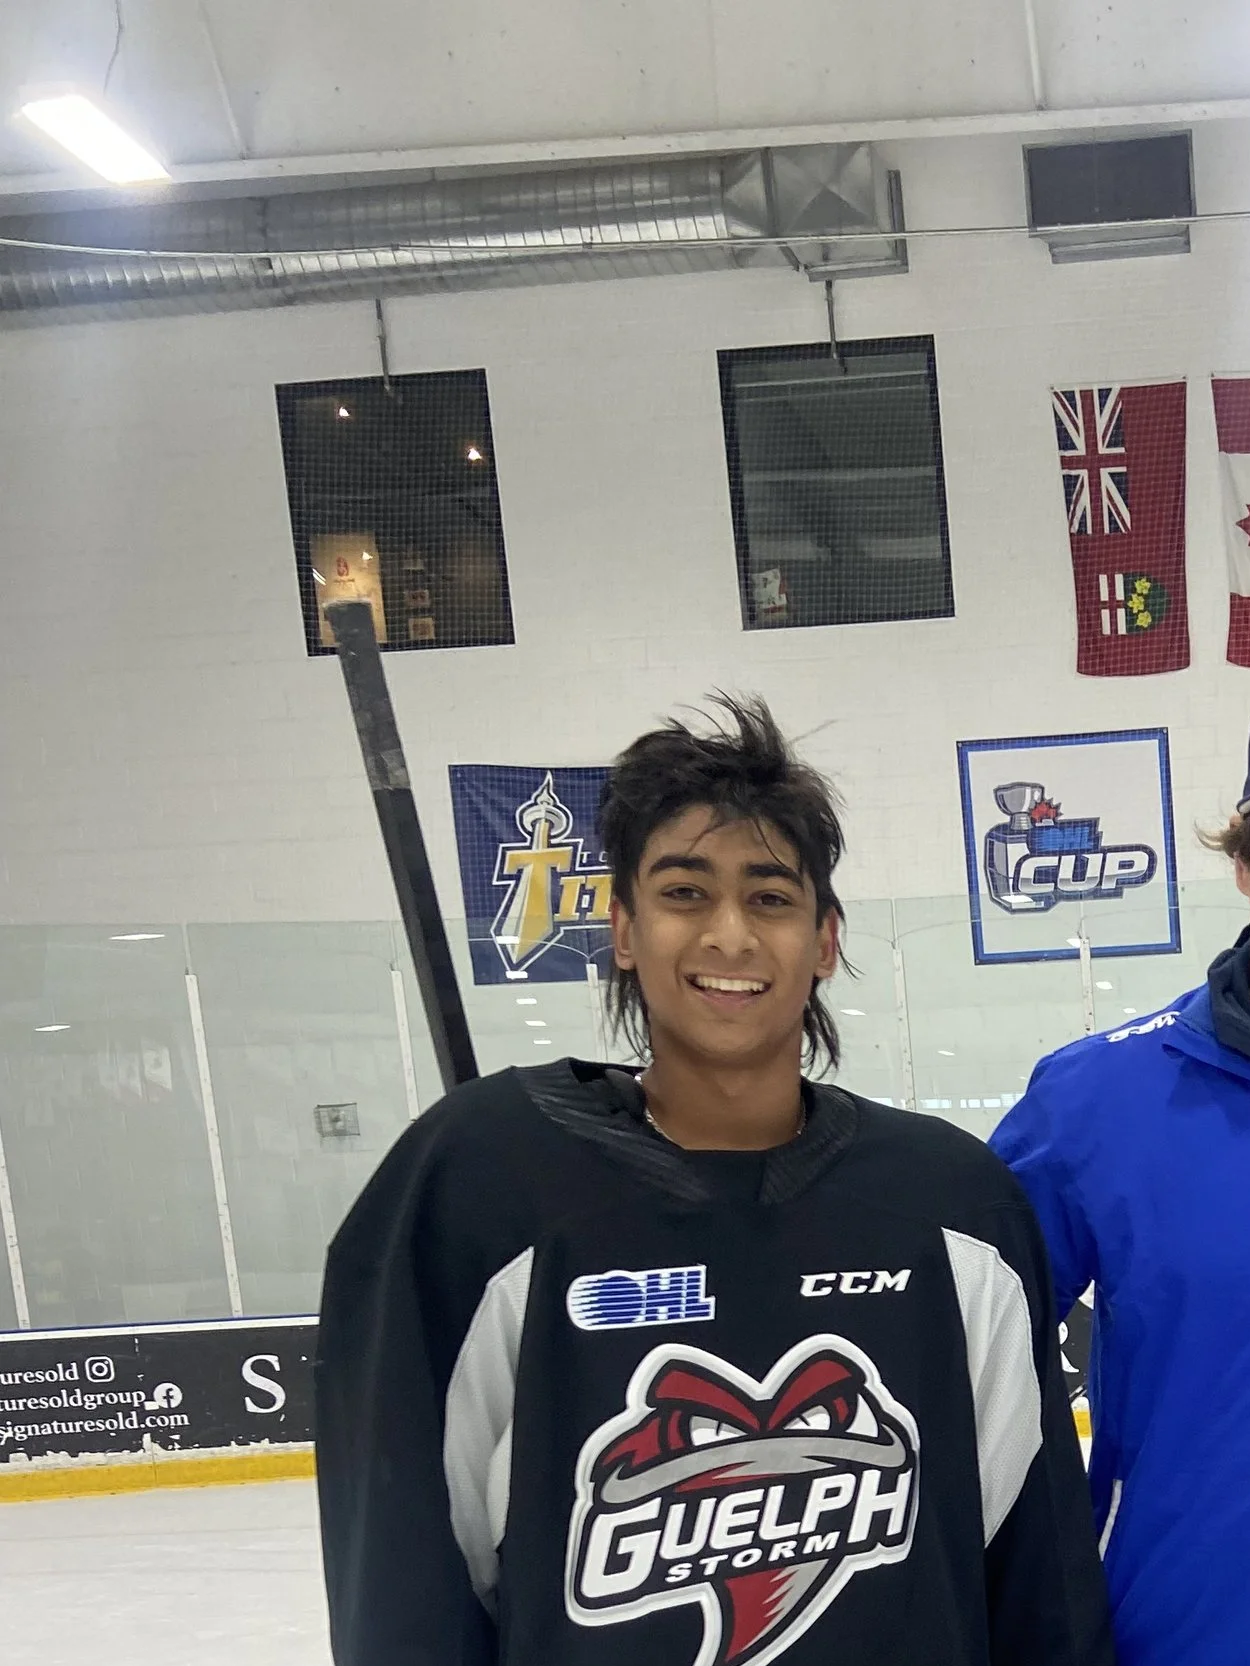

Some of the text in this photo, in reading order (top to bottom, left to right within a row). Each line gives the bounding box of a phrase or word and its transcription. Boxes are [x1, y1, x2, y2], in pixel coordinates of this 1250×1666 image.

[1018, 849, 1150, 894] CUP
[566, 1264, 716, 1331] OHL
[800, 1269, 912, 1297] CCM
[241, 1354, 286, 1414] S
[580, 1468, 913, 1598] GUELPH
[665, 1531, 842, 1584] STORM
